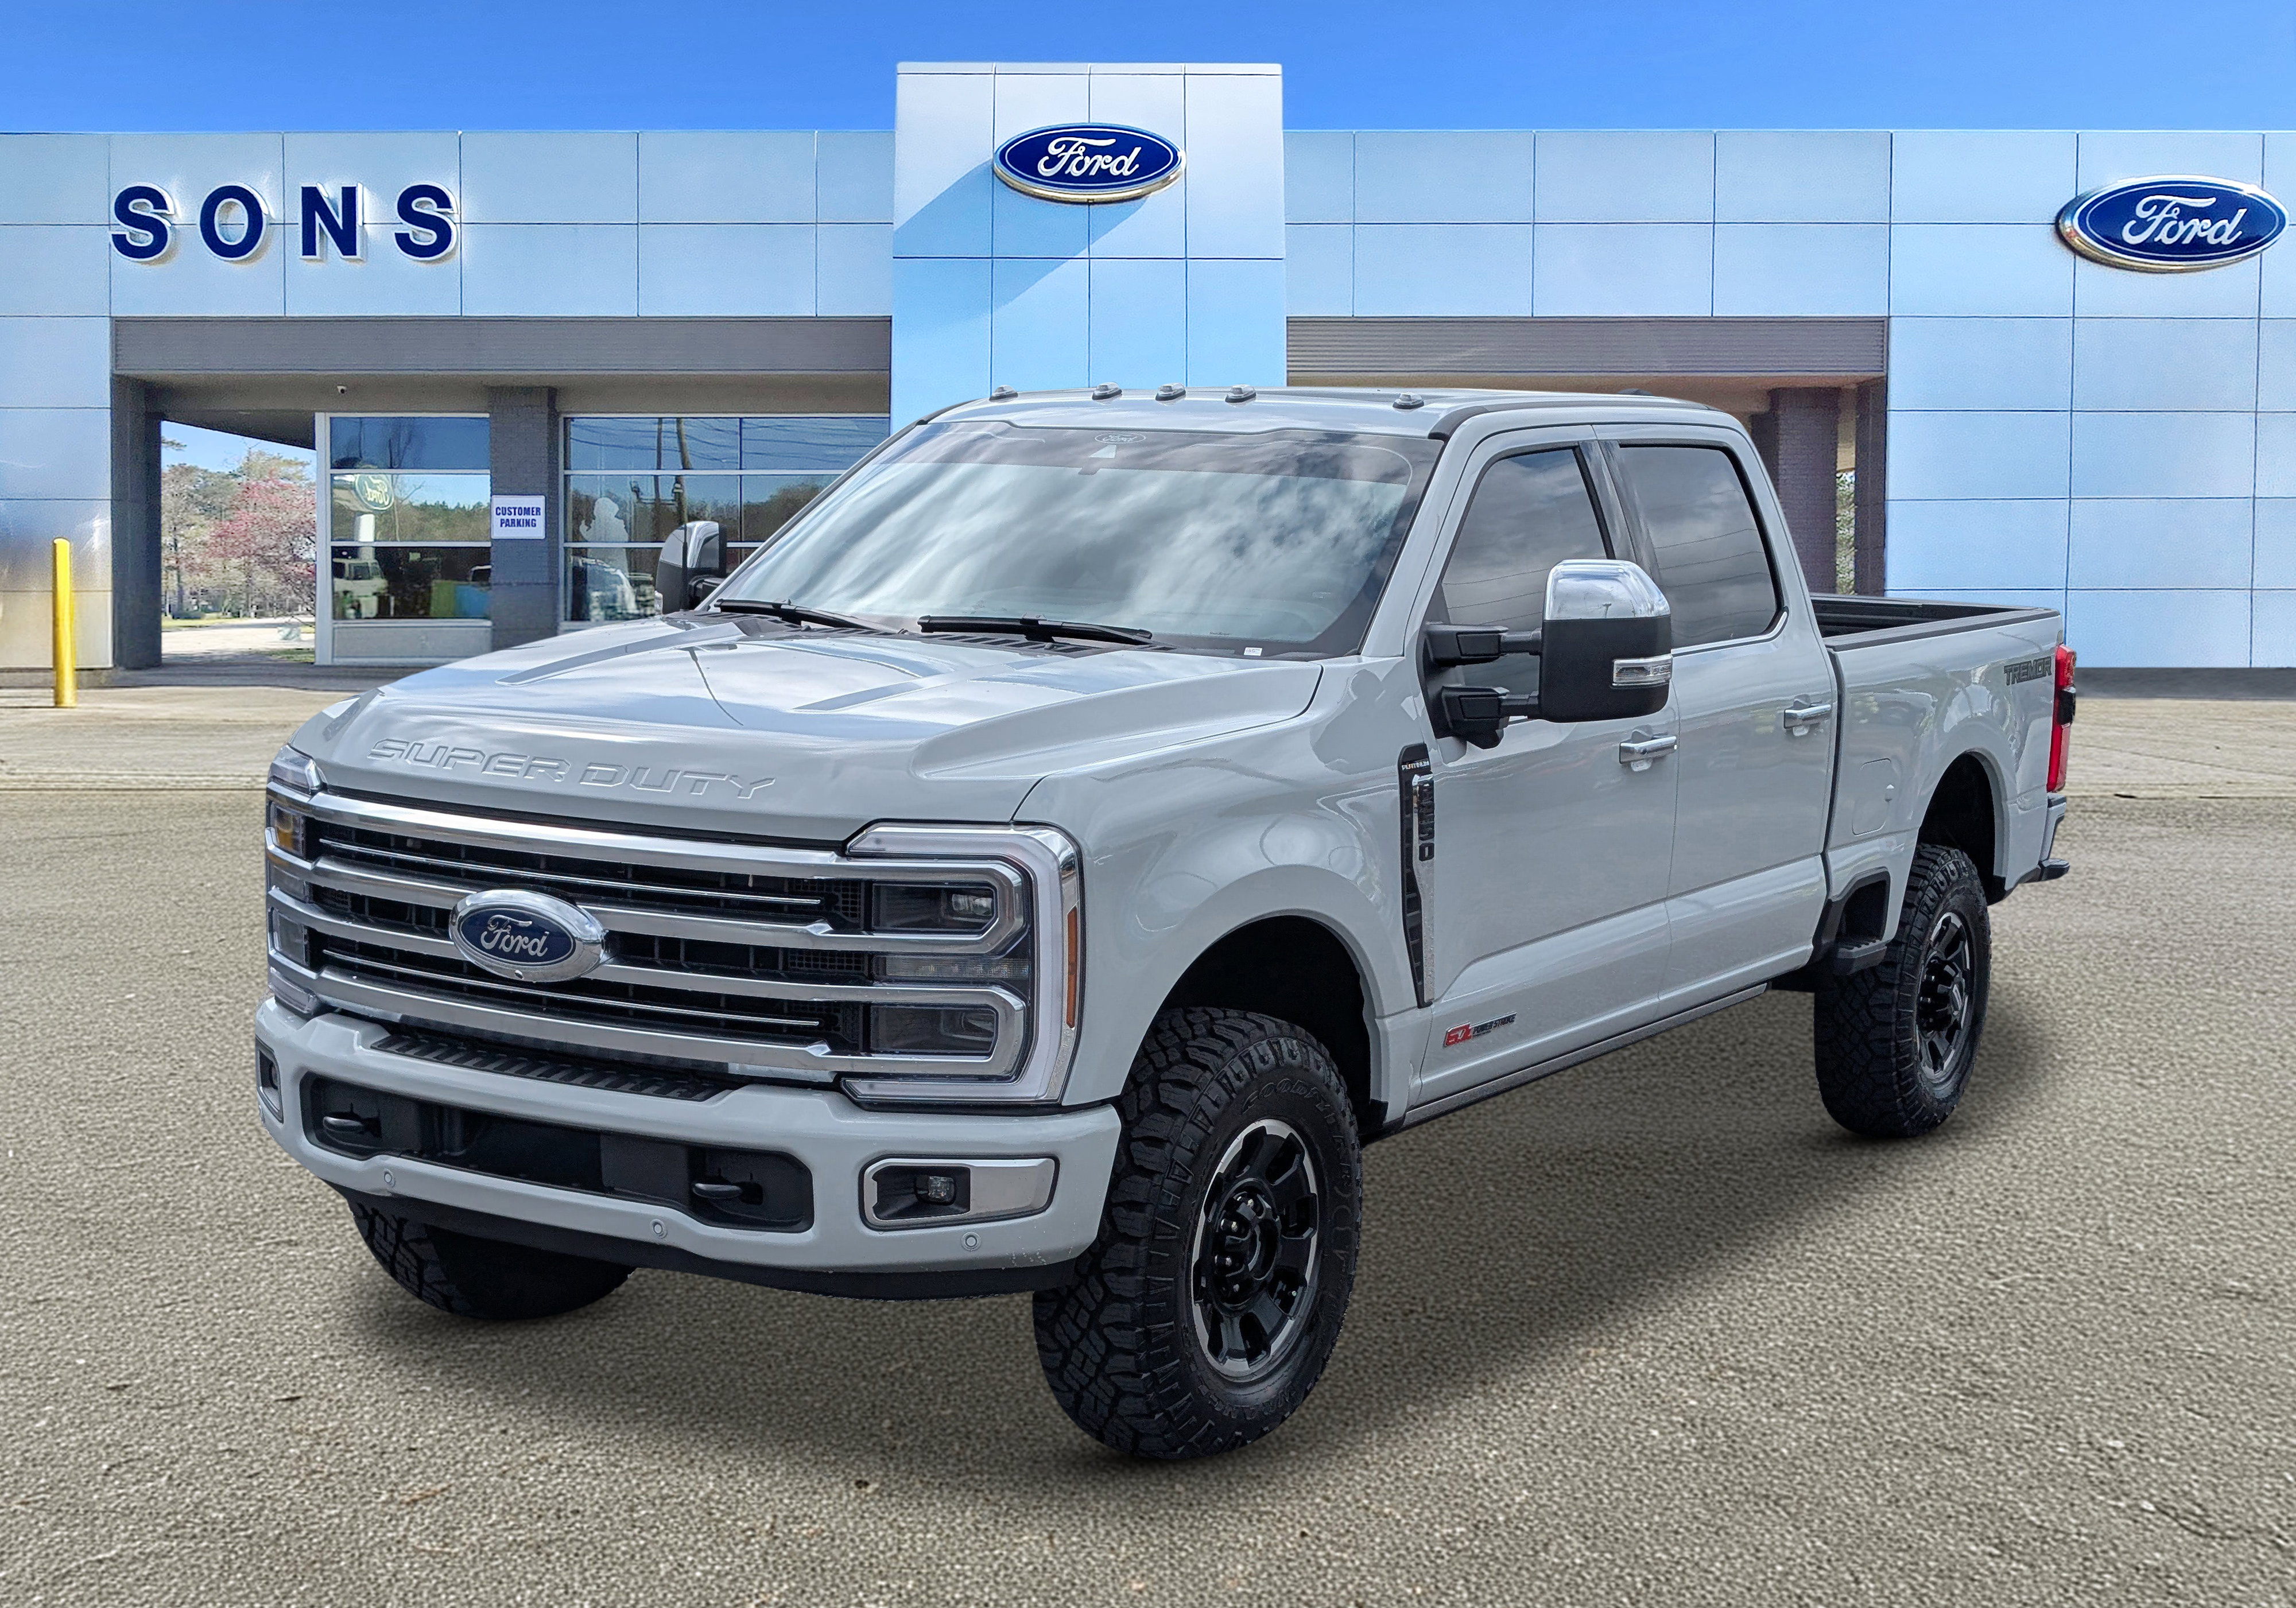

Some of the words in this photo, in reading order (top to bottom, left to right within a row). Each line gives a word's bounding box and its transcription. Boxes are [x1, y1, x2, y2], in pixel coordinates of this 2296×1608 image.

[1037, 137, 1142, 177] Ford
[111, 182, 460, 262] SONS
[2122, 195, 2248, 246] Ford
[495, 507, 541, 516] CUSTOMER
[500, 518, 537, 527] PARKING
[2004, 656, 2052, 686] TREMOR
[367, 738, 572, 783] SUPER
[579, 762, 775, 799] DUTY
[480, 914, 550, 957] Ford
